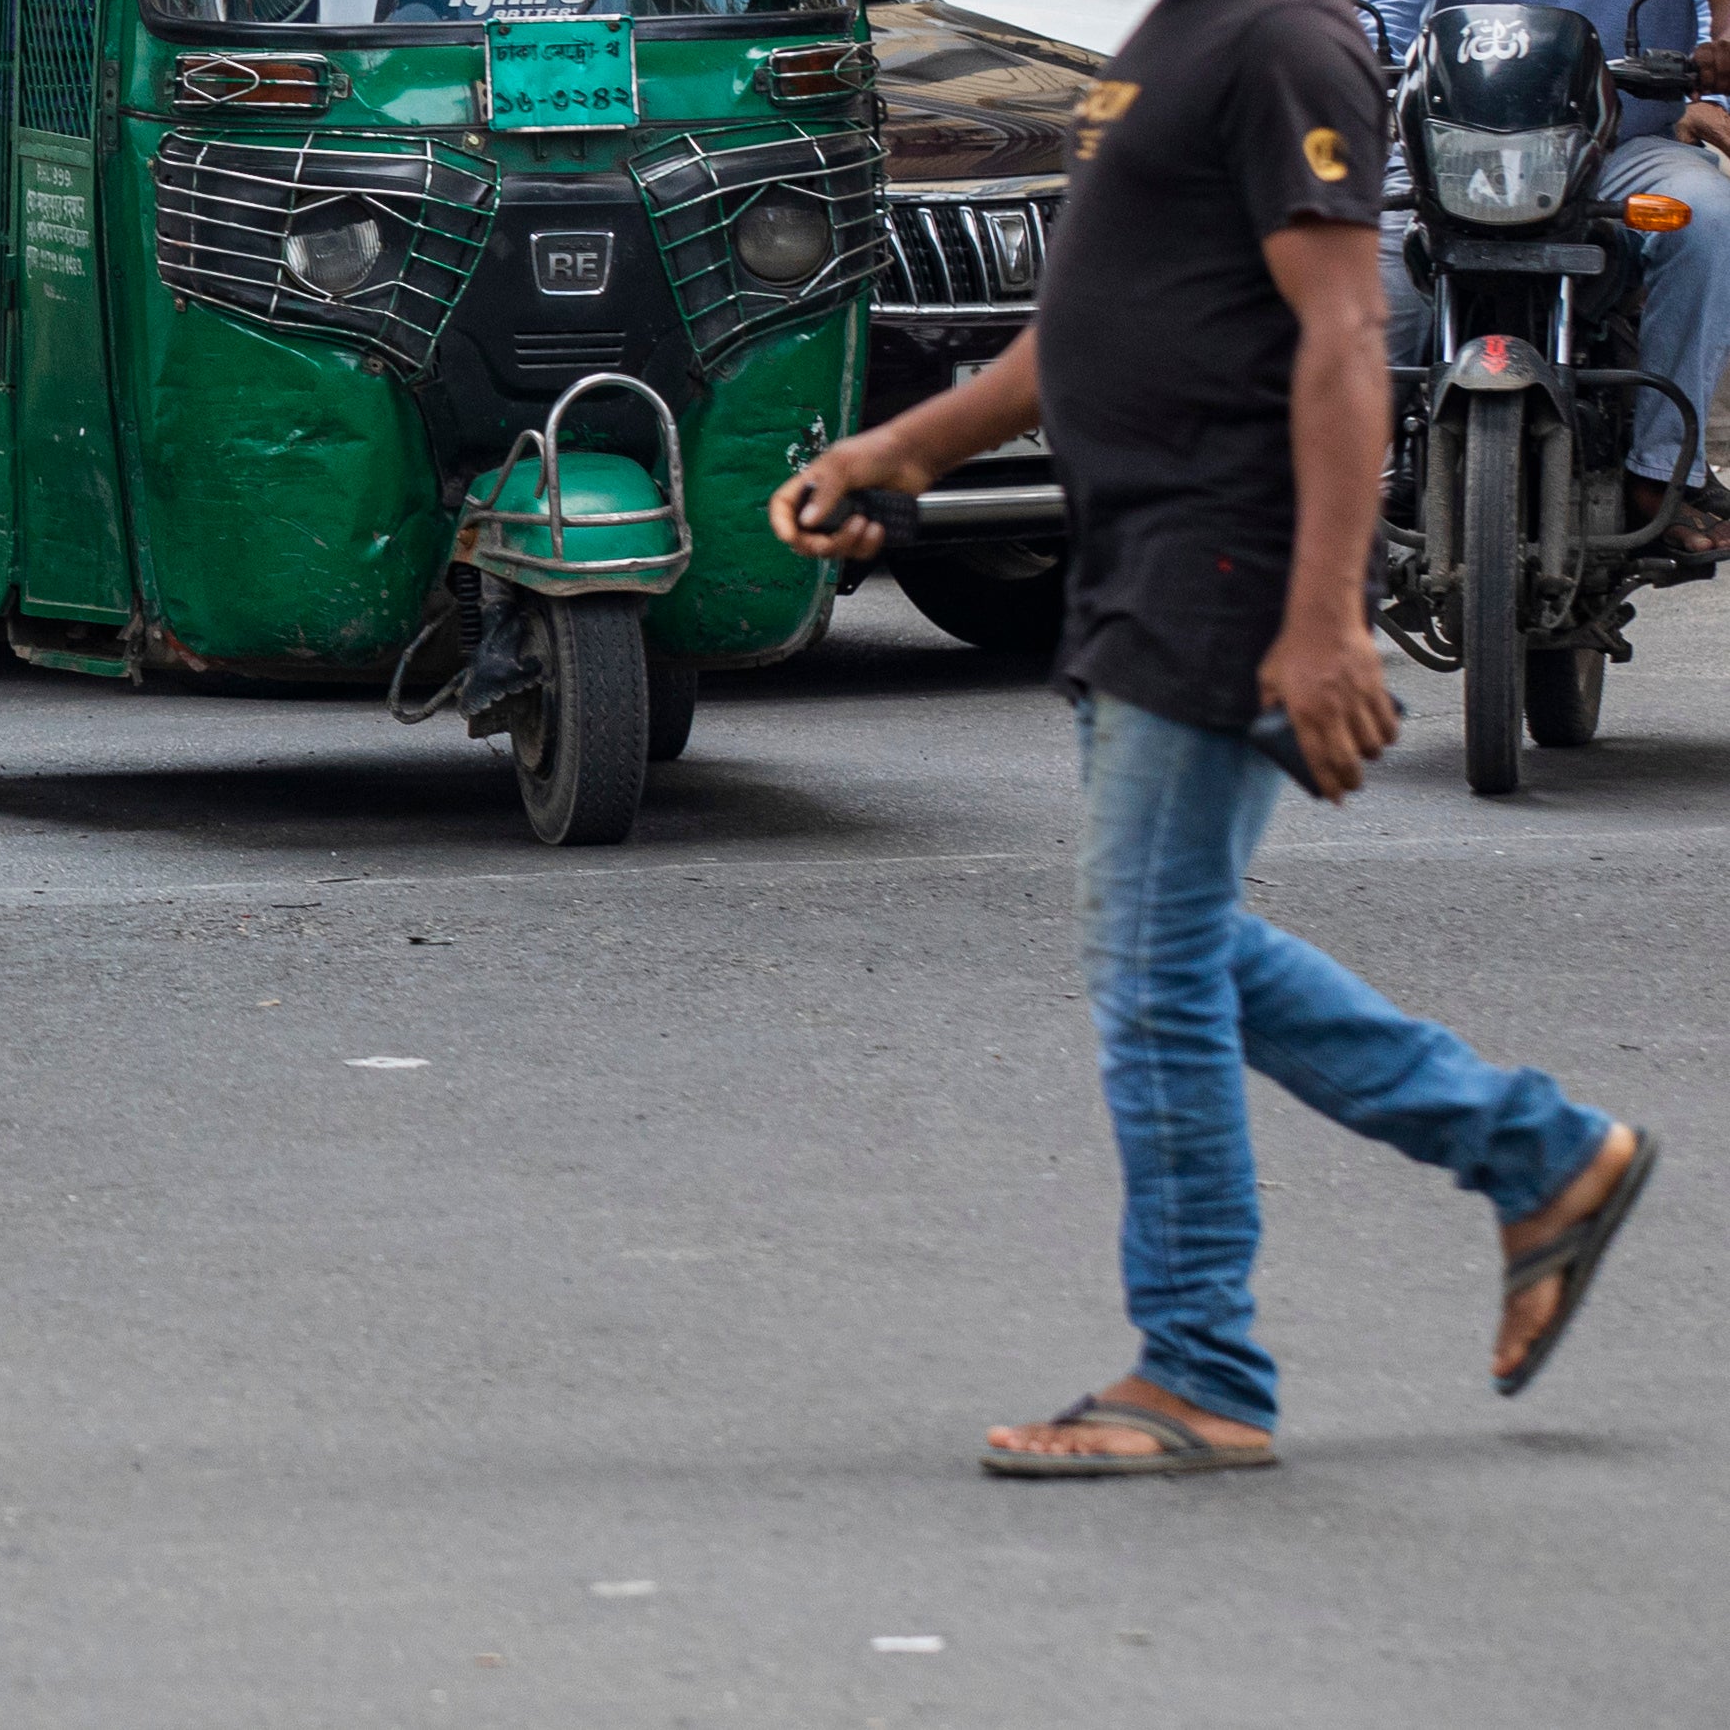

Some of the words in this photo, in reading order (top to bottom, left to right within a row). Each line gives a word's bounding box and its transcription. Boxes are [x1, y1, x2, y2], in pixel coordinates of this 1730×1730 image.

[492, 43, 538, 62] ঢাকা
[494, 86, 631, 114] ১৬-৩২৪২
[548, 252, 599, 281] RE
